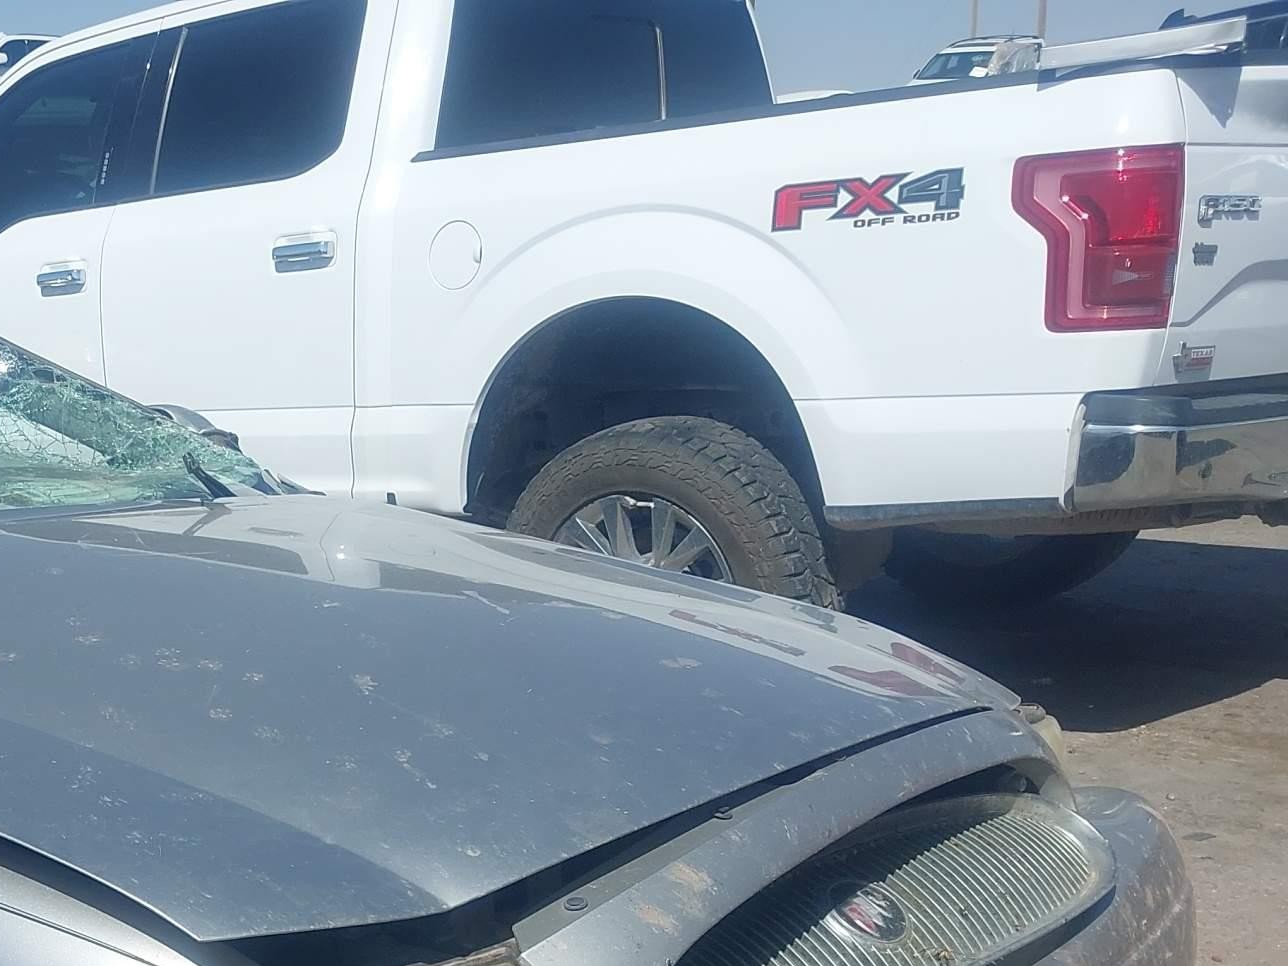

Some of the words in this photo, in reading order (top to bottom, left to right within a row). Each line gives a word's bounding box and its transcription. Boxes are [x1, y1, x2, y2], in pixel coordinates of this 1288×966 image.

[771, 167, 965, 232] FX4
[853, 216, 895, 228] OFF
[902, 211, 961, 225] ROAD
